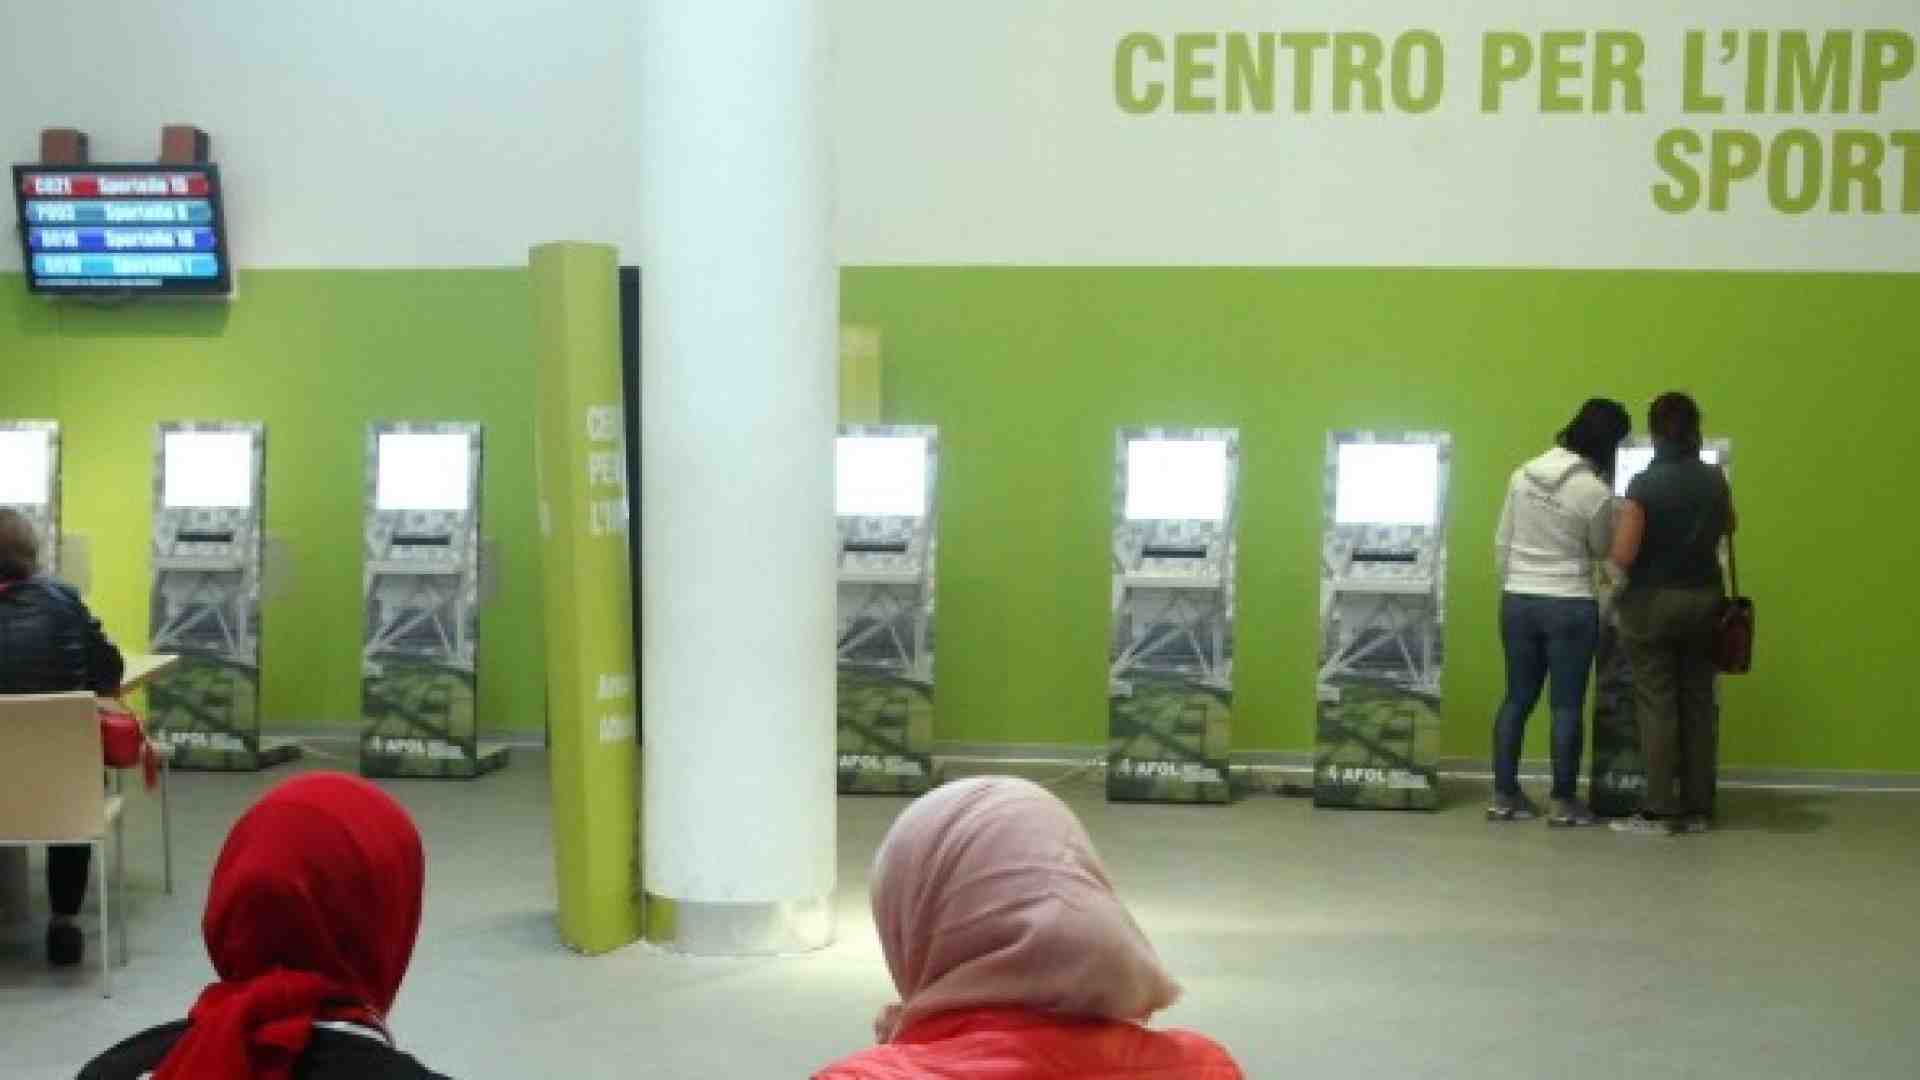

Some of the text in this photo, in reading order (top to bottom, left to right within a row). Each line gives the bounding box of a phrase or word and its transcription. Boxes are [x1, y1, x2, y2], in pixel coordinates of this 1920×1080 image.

[1113, 29, 1445, 115] CENTRO
[1480, 30, 1646, 114] PER
[1343, 767, 1387, 783] AFOL
